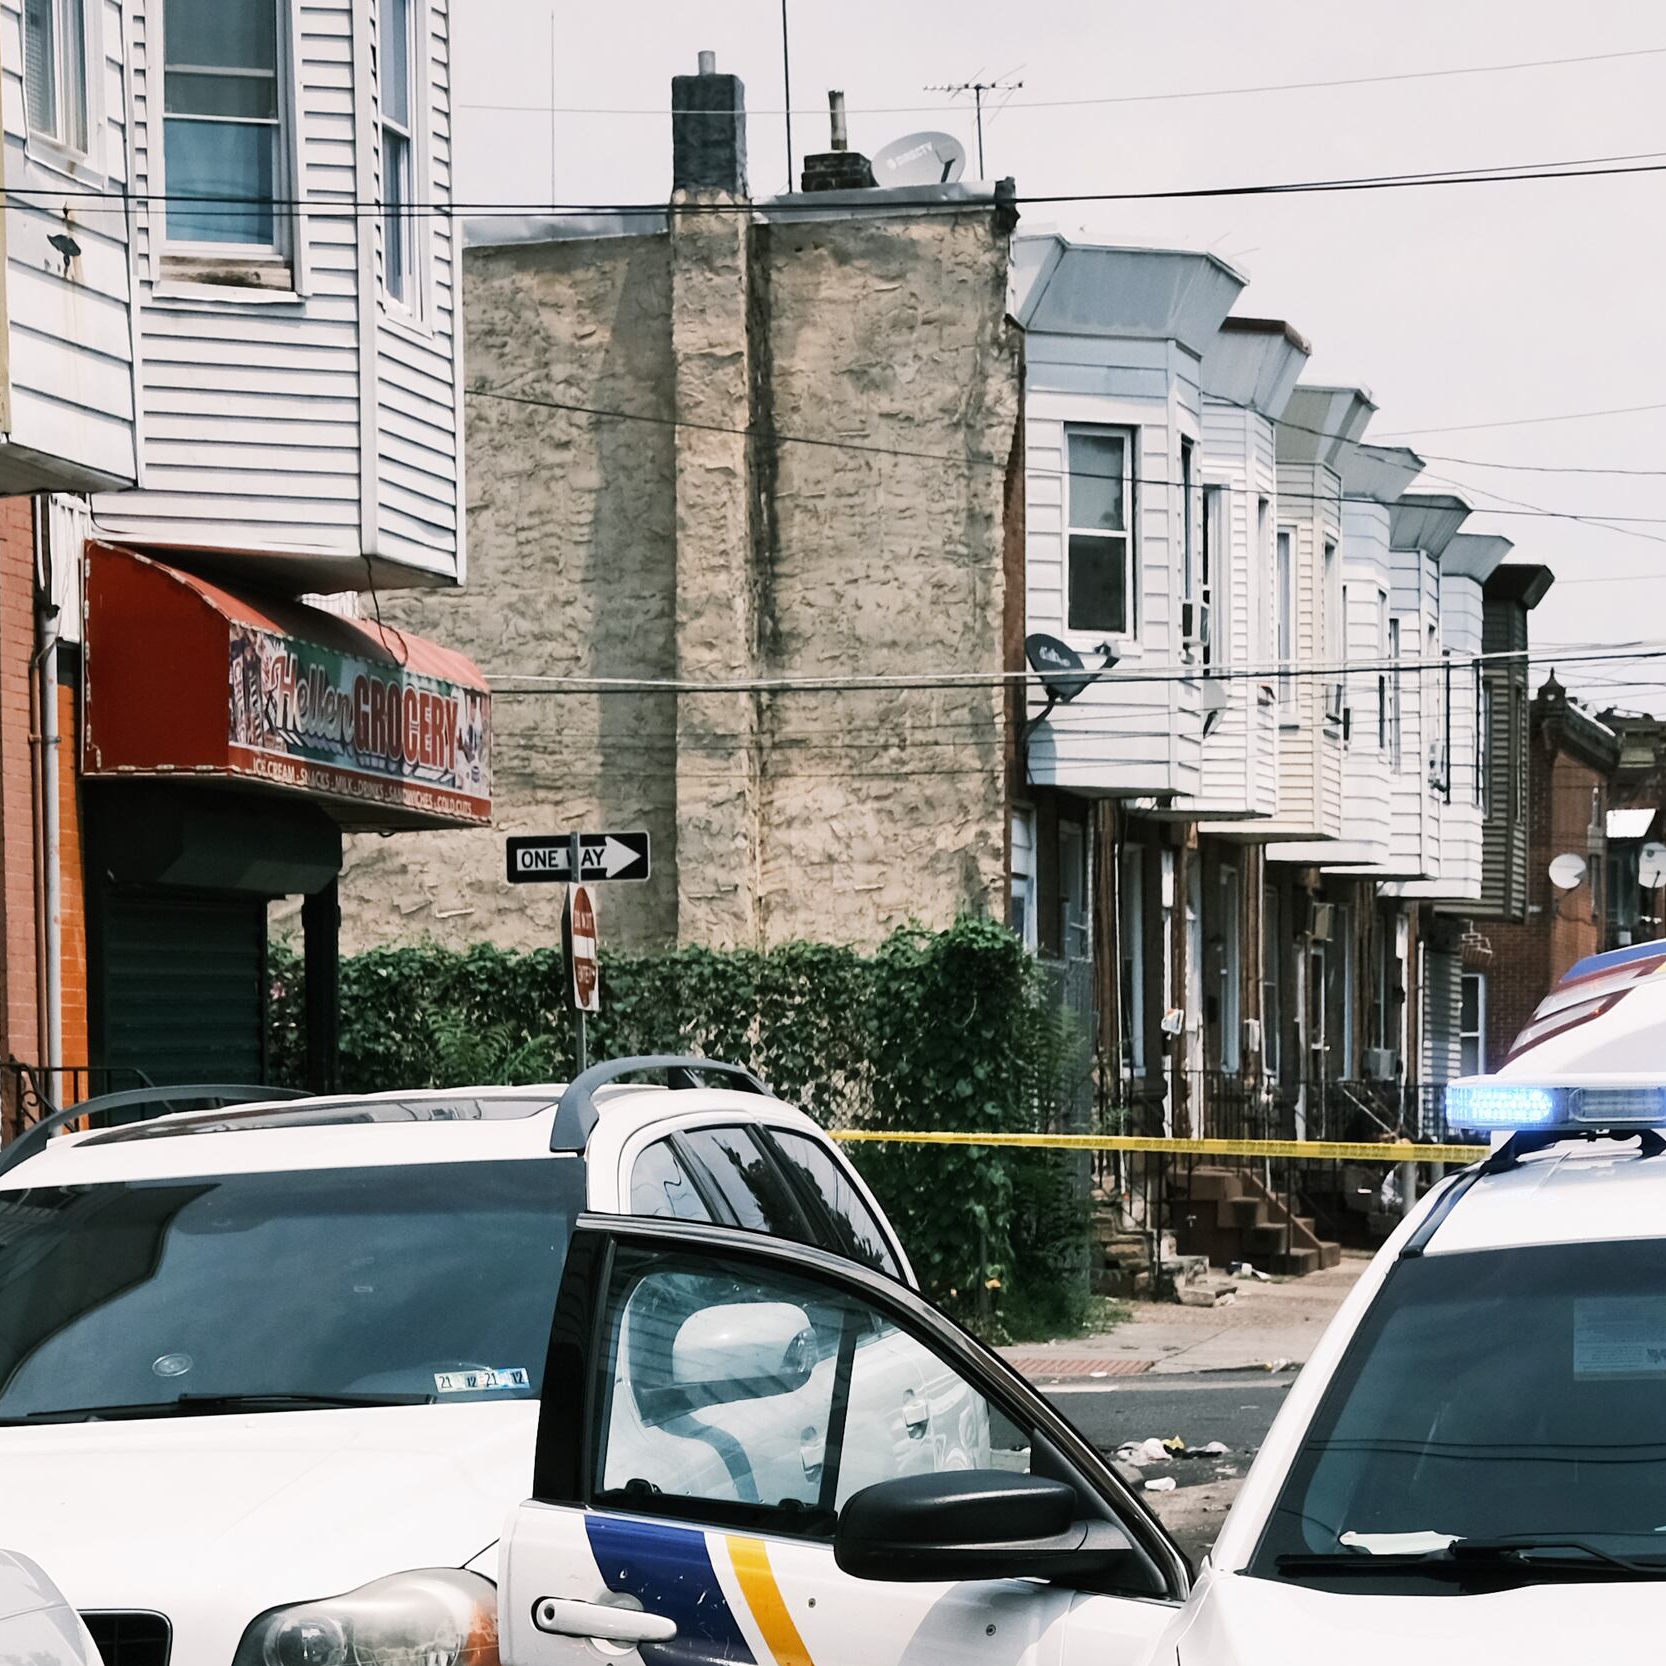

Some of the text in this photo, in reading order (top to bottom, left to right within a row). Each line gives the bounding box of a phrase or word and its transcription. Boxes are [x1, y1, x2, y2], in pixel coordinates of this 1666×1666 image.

[268, 651, 356, 744] Hellen
[353, 673, 459, 771] GROCERY
[267, 760, 296, 785] CREAM
[521, 848, 605, 869] ONE AY
